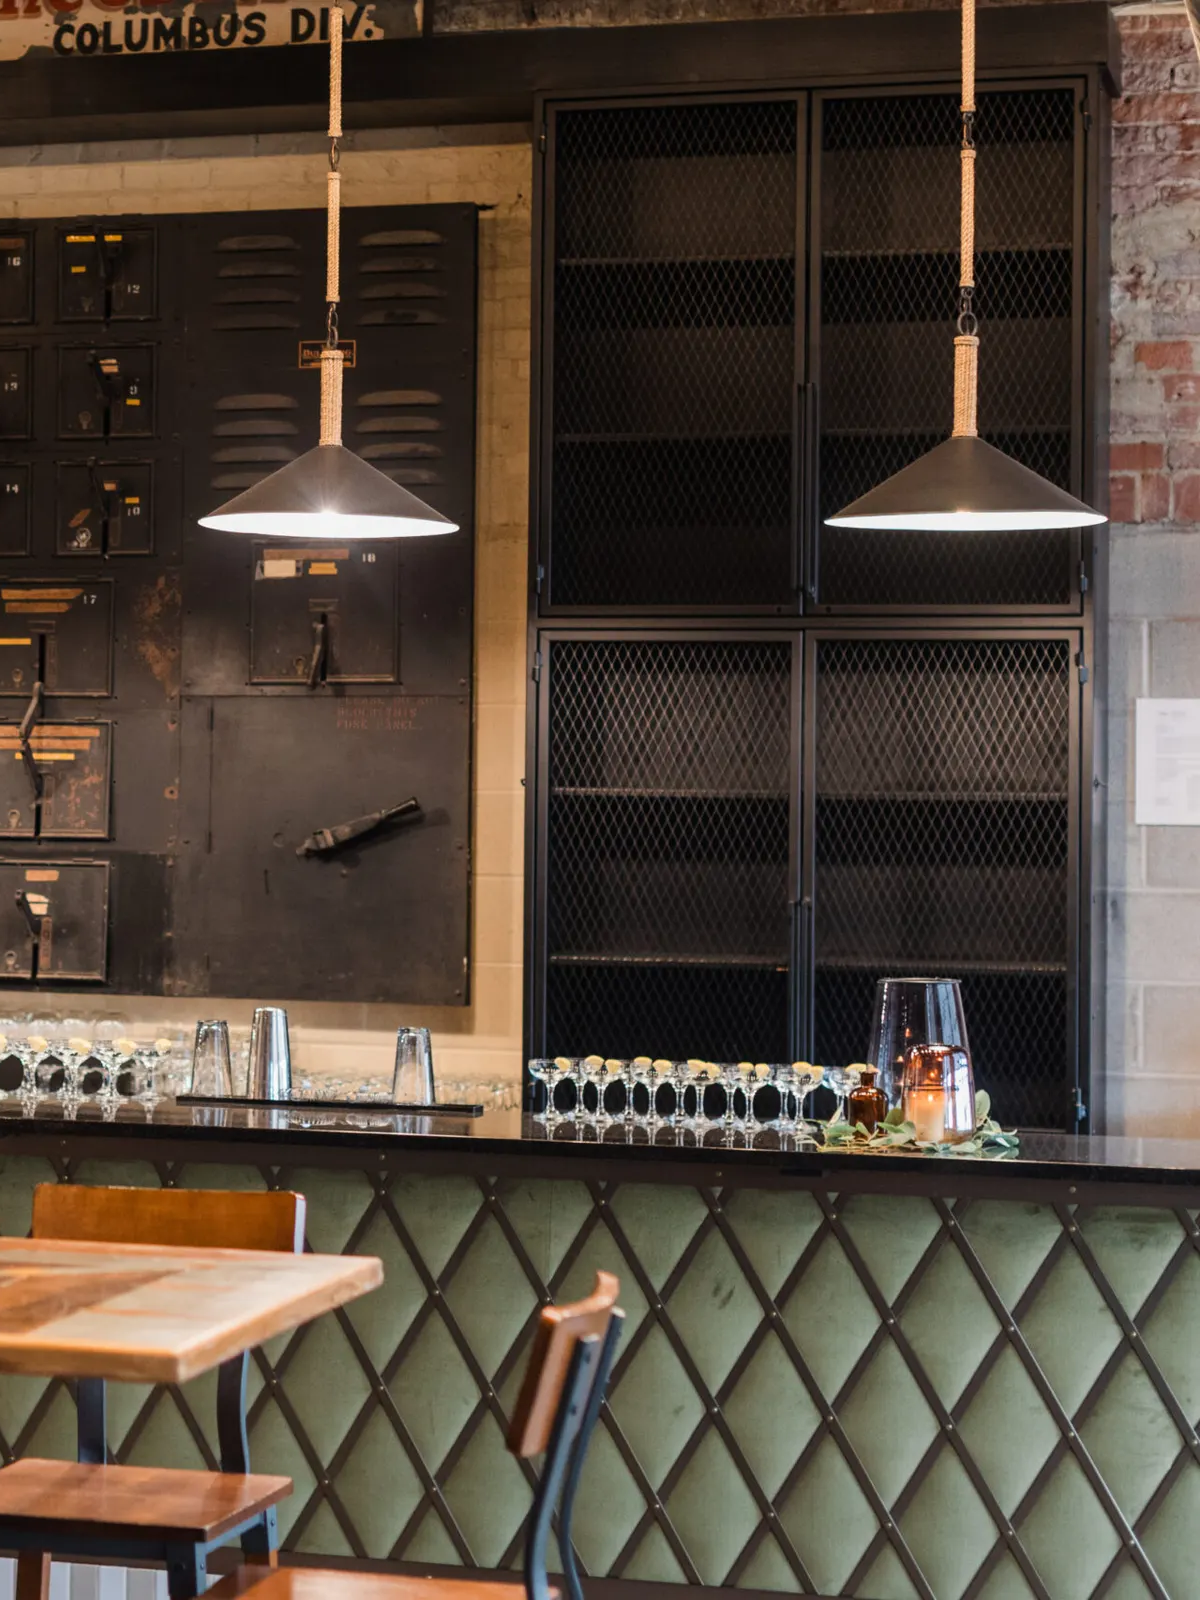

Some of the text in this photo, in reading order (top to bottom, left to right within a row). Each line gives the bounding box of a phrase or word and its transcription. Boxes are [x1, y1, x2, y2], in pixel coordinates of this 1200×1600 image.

[52, 12, 267, 56] COLUMBUS
[290, 5, 374, 44] DIV.
[127, 284, 140, 294] 12
[6, 484, 19, 494] 14
[83, 594, 97, 605] 17
